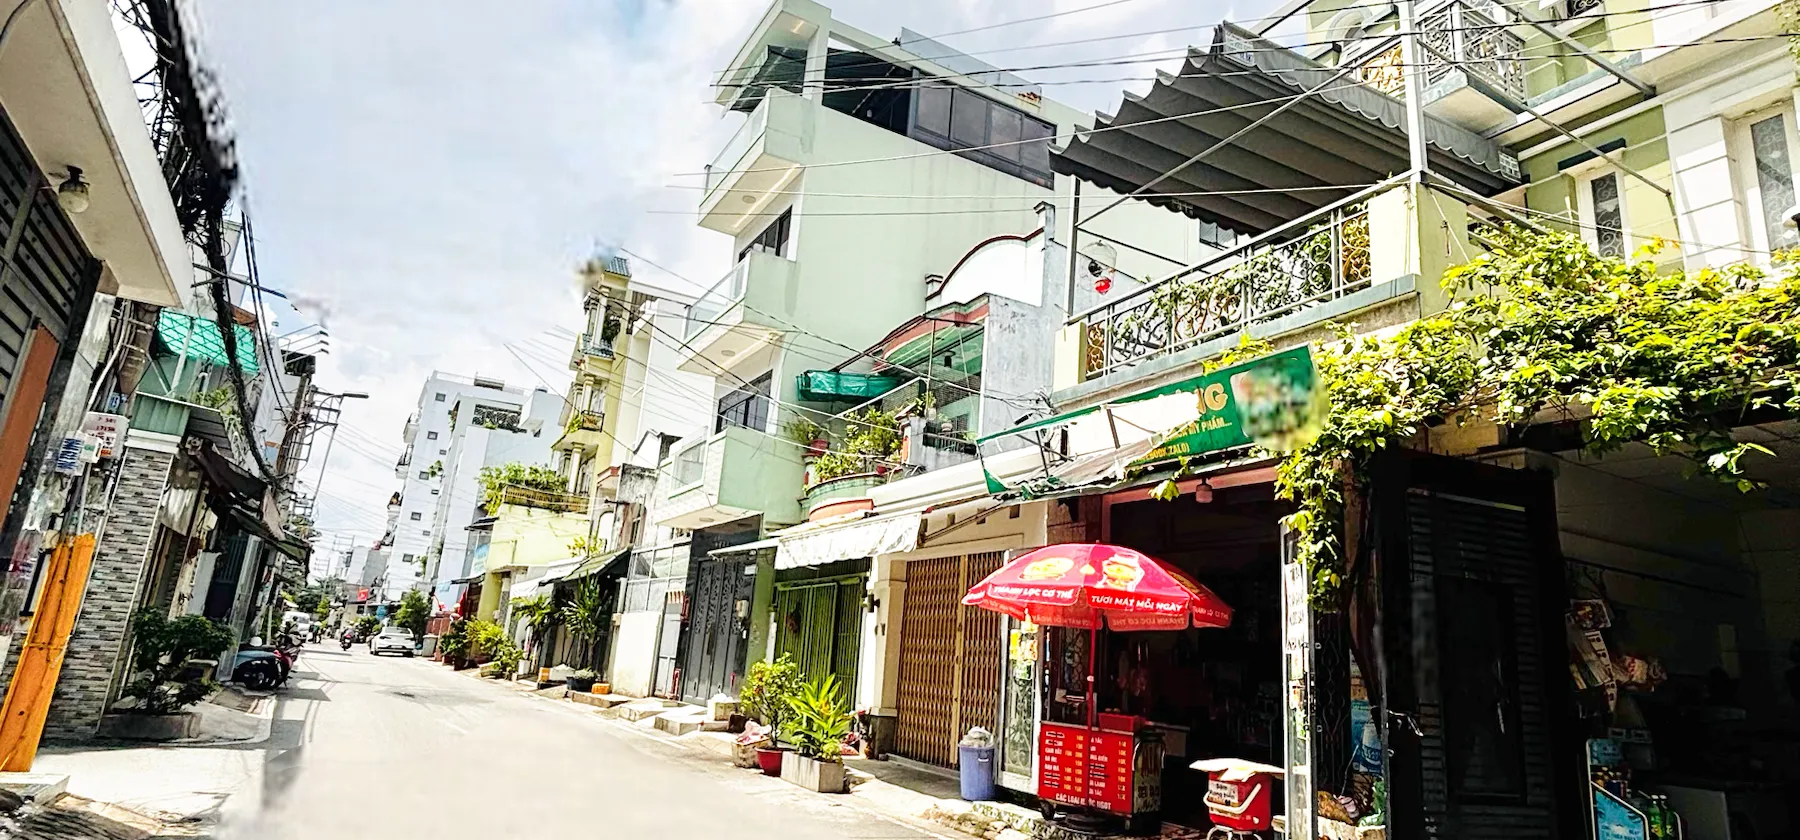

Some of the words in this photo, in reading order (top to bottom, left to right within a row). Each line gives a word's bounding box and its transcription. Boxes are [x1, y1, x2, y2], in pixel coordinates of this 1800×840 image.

[994, 586, 1023, 595] THANH
[1023, 587, 1041, 597] LỌC
[1042, 588, 1056, 598] CƠ
[1091, 595, 1113, 604] TƯƠI
[1114, 596, 1135, 606] MÁT
[1136, 598, 1155, 609] MỖI
[1156, 601, 1183, 612] NGÀY
